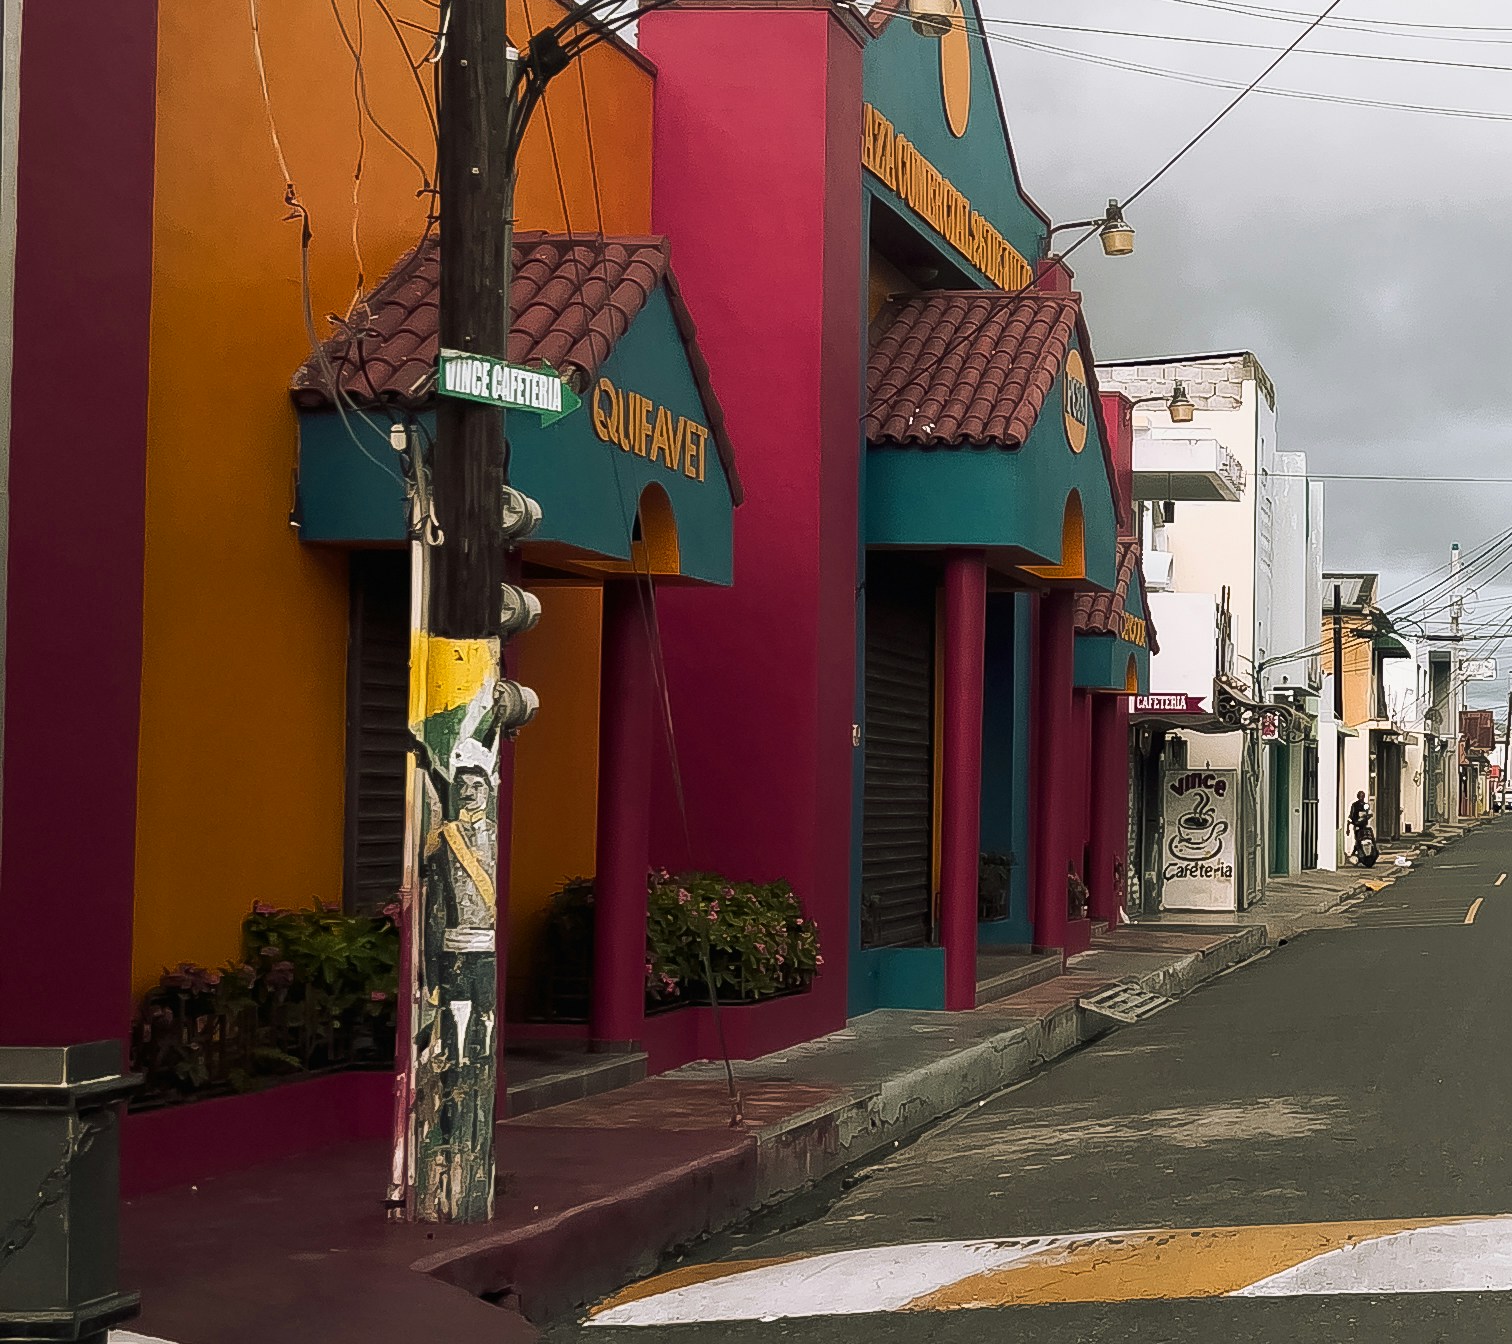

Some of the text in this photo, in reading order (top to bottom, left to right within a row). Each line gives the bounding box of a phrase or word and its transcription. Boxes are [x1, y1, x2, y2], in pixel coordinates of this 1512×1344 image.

[862, 102, 896, 193] AZA
[445, 358, 563, 412] VINCE CAFETERIA
[593, 377, 708, 482] QUIFAVET
[1136, 694, 1187, 710] CAFETERIA
